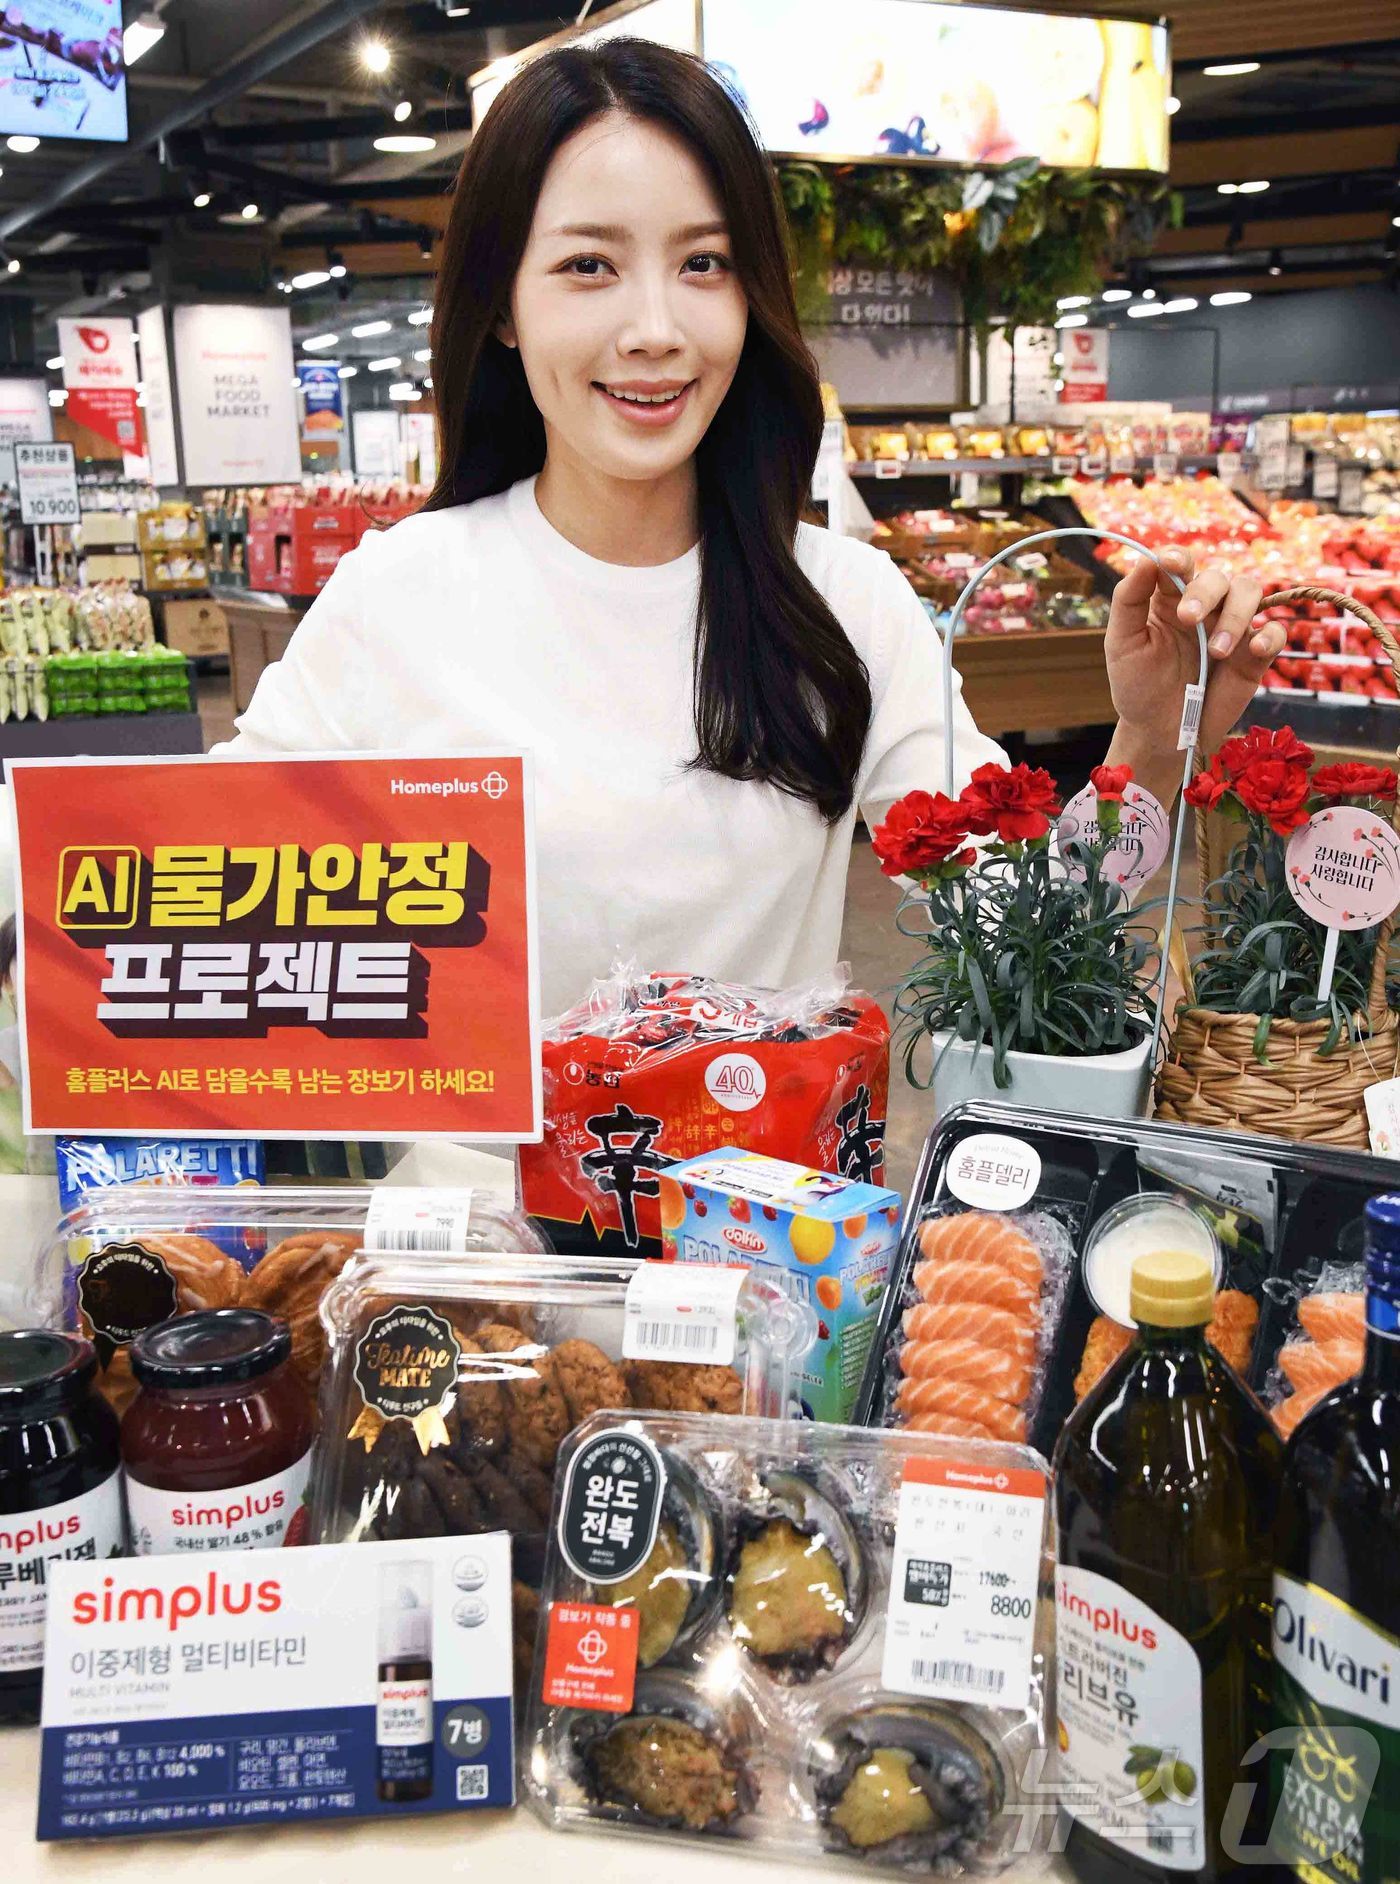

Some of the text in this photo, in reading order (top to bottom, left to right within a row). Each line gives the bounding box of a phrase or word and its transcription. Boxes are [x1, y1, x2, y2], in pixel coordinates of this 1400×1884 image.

[215, 389, 262, 402] FOOD
[206, 404, 271, 419] MARKET
[390, 778, 479, 797] Homeplus
[1314, 845, 1378, 874] 감사합니다
[62, 841, 469, 928] AI 물가안정
[1311, 863, 1374, 892] 사랑합니다
[96, 941, 412, 1022] 프로젝트
[66, 1067, 495, 1095] 홈플러스 AI로 담을수록 남는 장보기 하세요!
[715, 1065, 754, 1095] 40
[957, 1155, 1031, 1191] 홈플델리
[725, 1228, 762, 1250] dolfin
[364, 1342, 451, 1370] Teatime
[378, 1367, 432, 1388] MATE
[585, 1474, 640, 1511] 완도
[172, 1490, 285, 1529] simplus
[175, 1536, 205, 1550] 국내산
[208, 1536, 230, 1549] 딸기
[233, 1531, 250, 1544] 48
[580, 1511, 635, 1550] 전복
[71, 1571, 283, 1632] simplus
[990, 1595, 1032, 1619] 8800
[1058, 1581, 1158, 1650] implus
[70, 1636, 306, 1679] 이중제형 멀티비타민
[1273, 1597, 1390, 1705] Olivari
[448, 1719, 483, 1744] 7병
